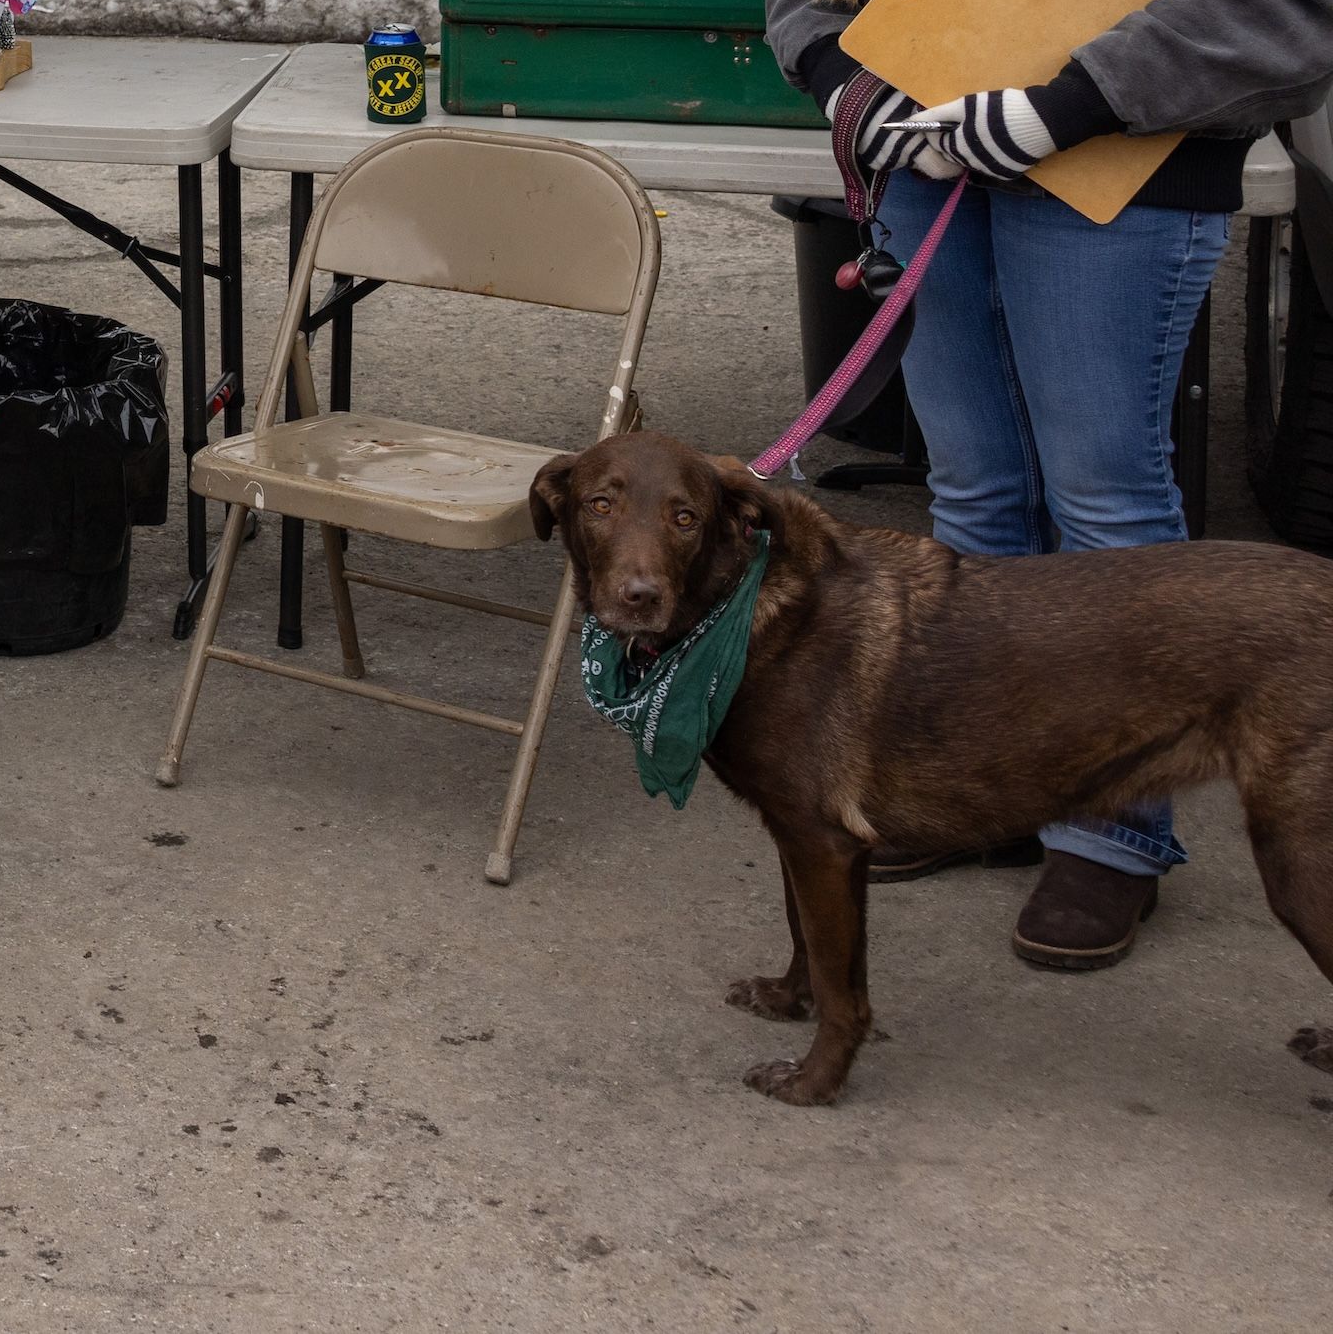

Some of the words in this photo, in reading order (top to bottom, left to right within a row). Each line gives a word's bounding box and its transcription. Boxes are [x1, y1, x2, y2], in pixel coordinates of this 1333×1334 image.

[371, 56, 396, 70] GREAT
[399, 57, 417, 70] SEAL
[393, 83, 424, 115] JEFFERSON
